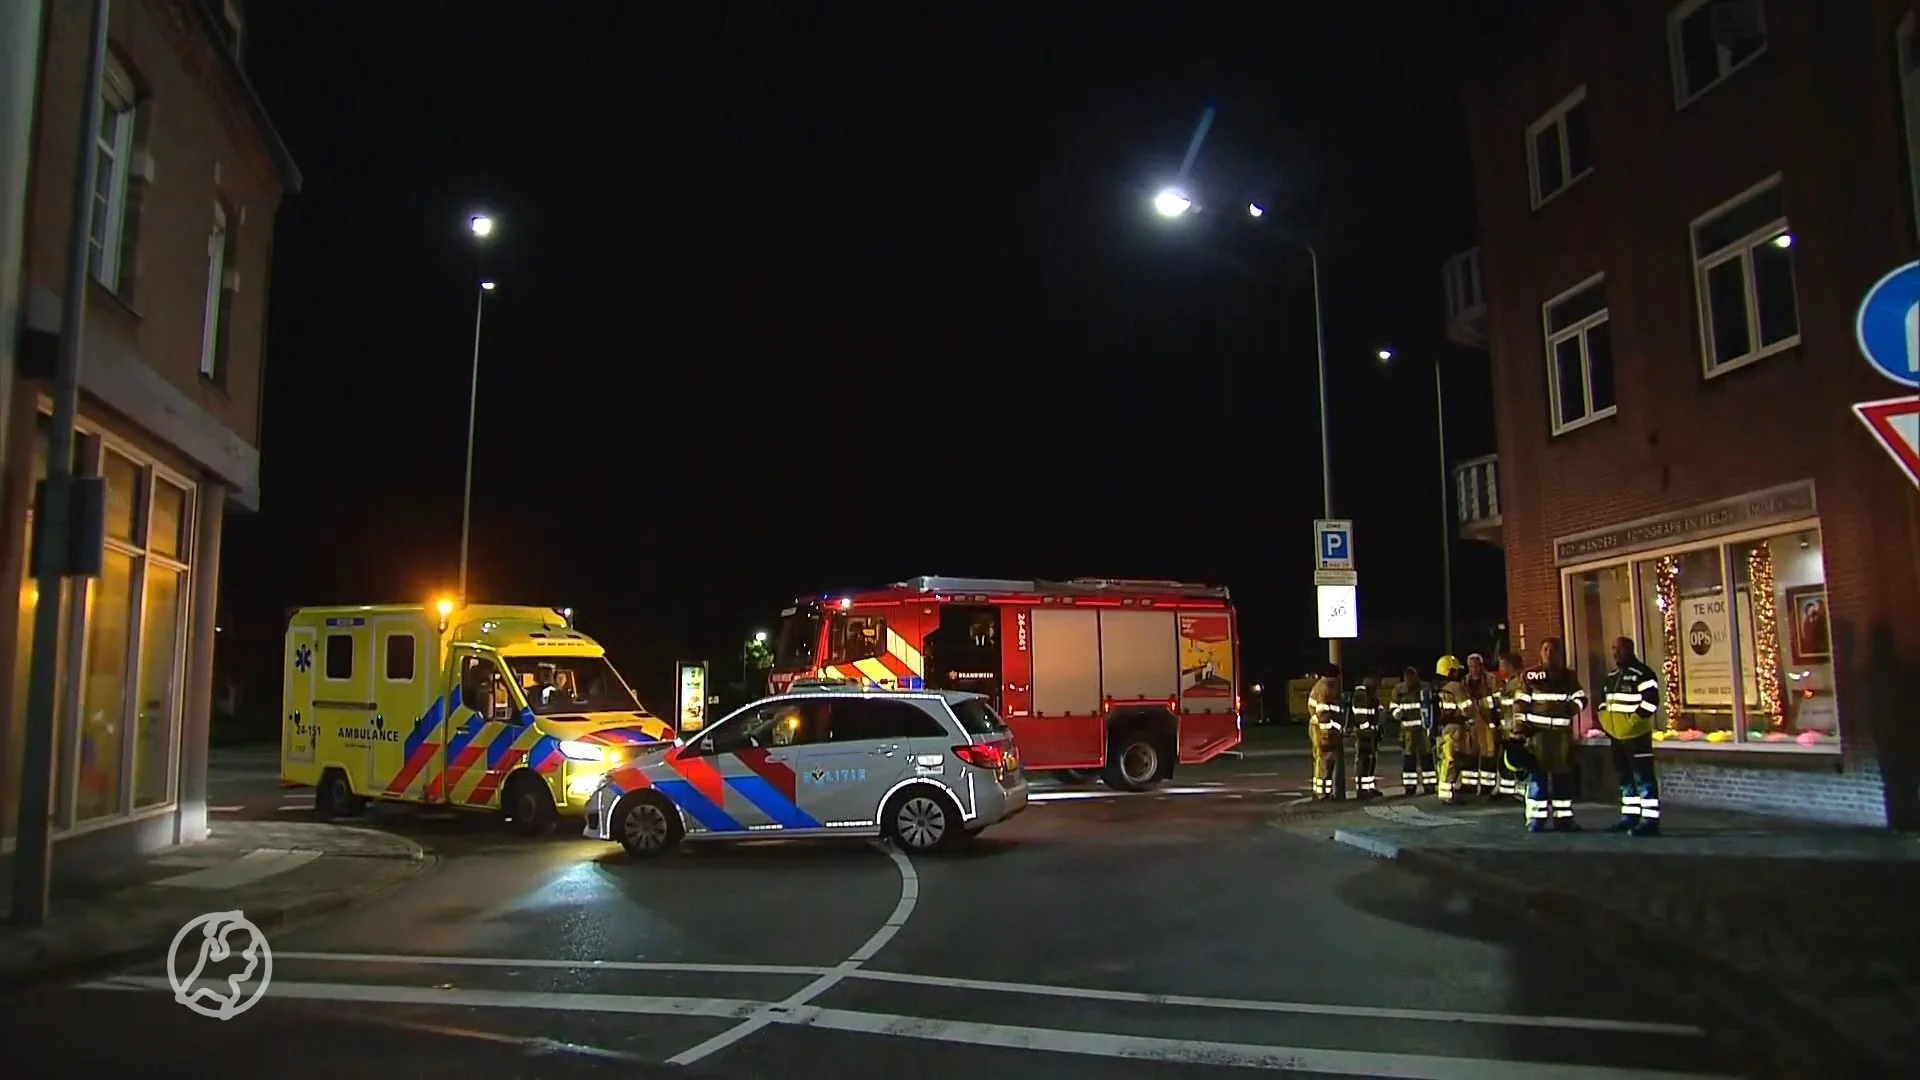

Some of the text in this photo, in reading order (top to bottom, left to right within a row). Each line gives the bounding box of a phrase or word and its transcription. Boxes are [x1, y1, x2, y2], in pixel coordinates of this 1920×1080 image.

[1327, 533, 1342, 556] P
[1693, 603, 1705, 615] TE
[1690, 630, 1711, 646] OPS
[338, 727, 400, 742] AMBULANCE
